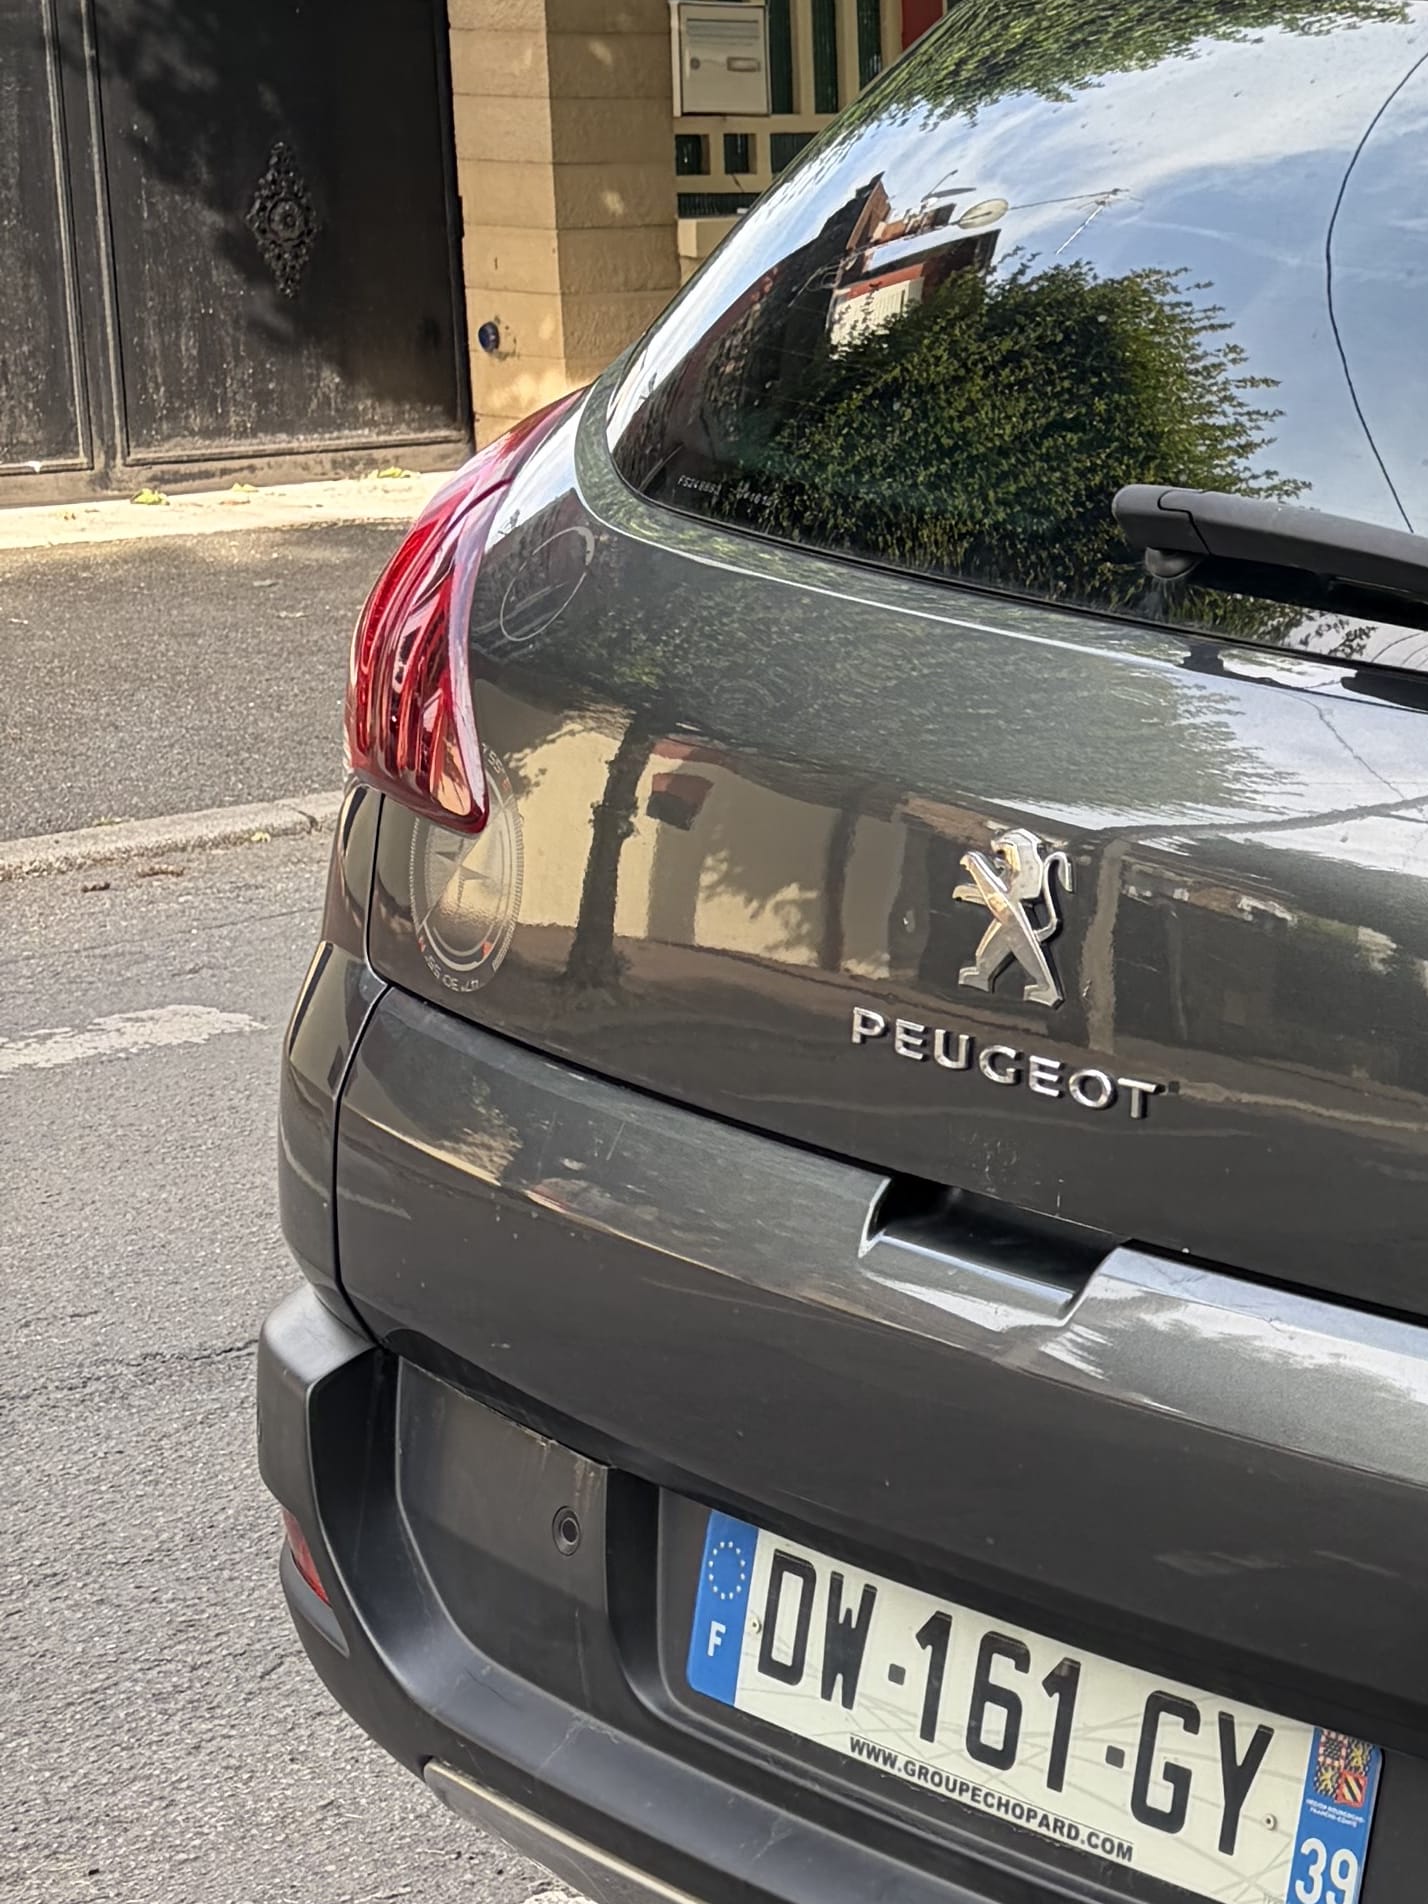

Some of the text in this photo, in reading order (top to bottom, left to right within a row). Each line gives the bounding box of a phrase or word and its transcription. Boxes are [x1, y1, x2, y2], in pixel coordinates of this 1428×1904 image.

[851, 1005, 1159, 1119] PEUGEOT
[707, 1620, 726, 1657] F
[757, 1548, 1275, 1857] DW-161-GY
[849, 1735, 1134, 1863] WWW.GROUPECHOPARD.COM
